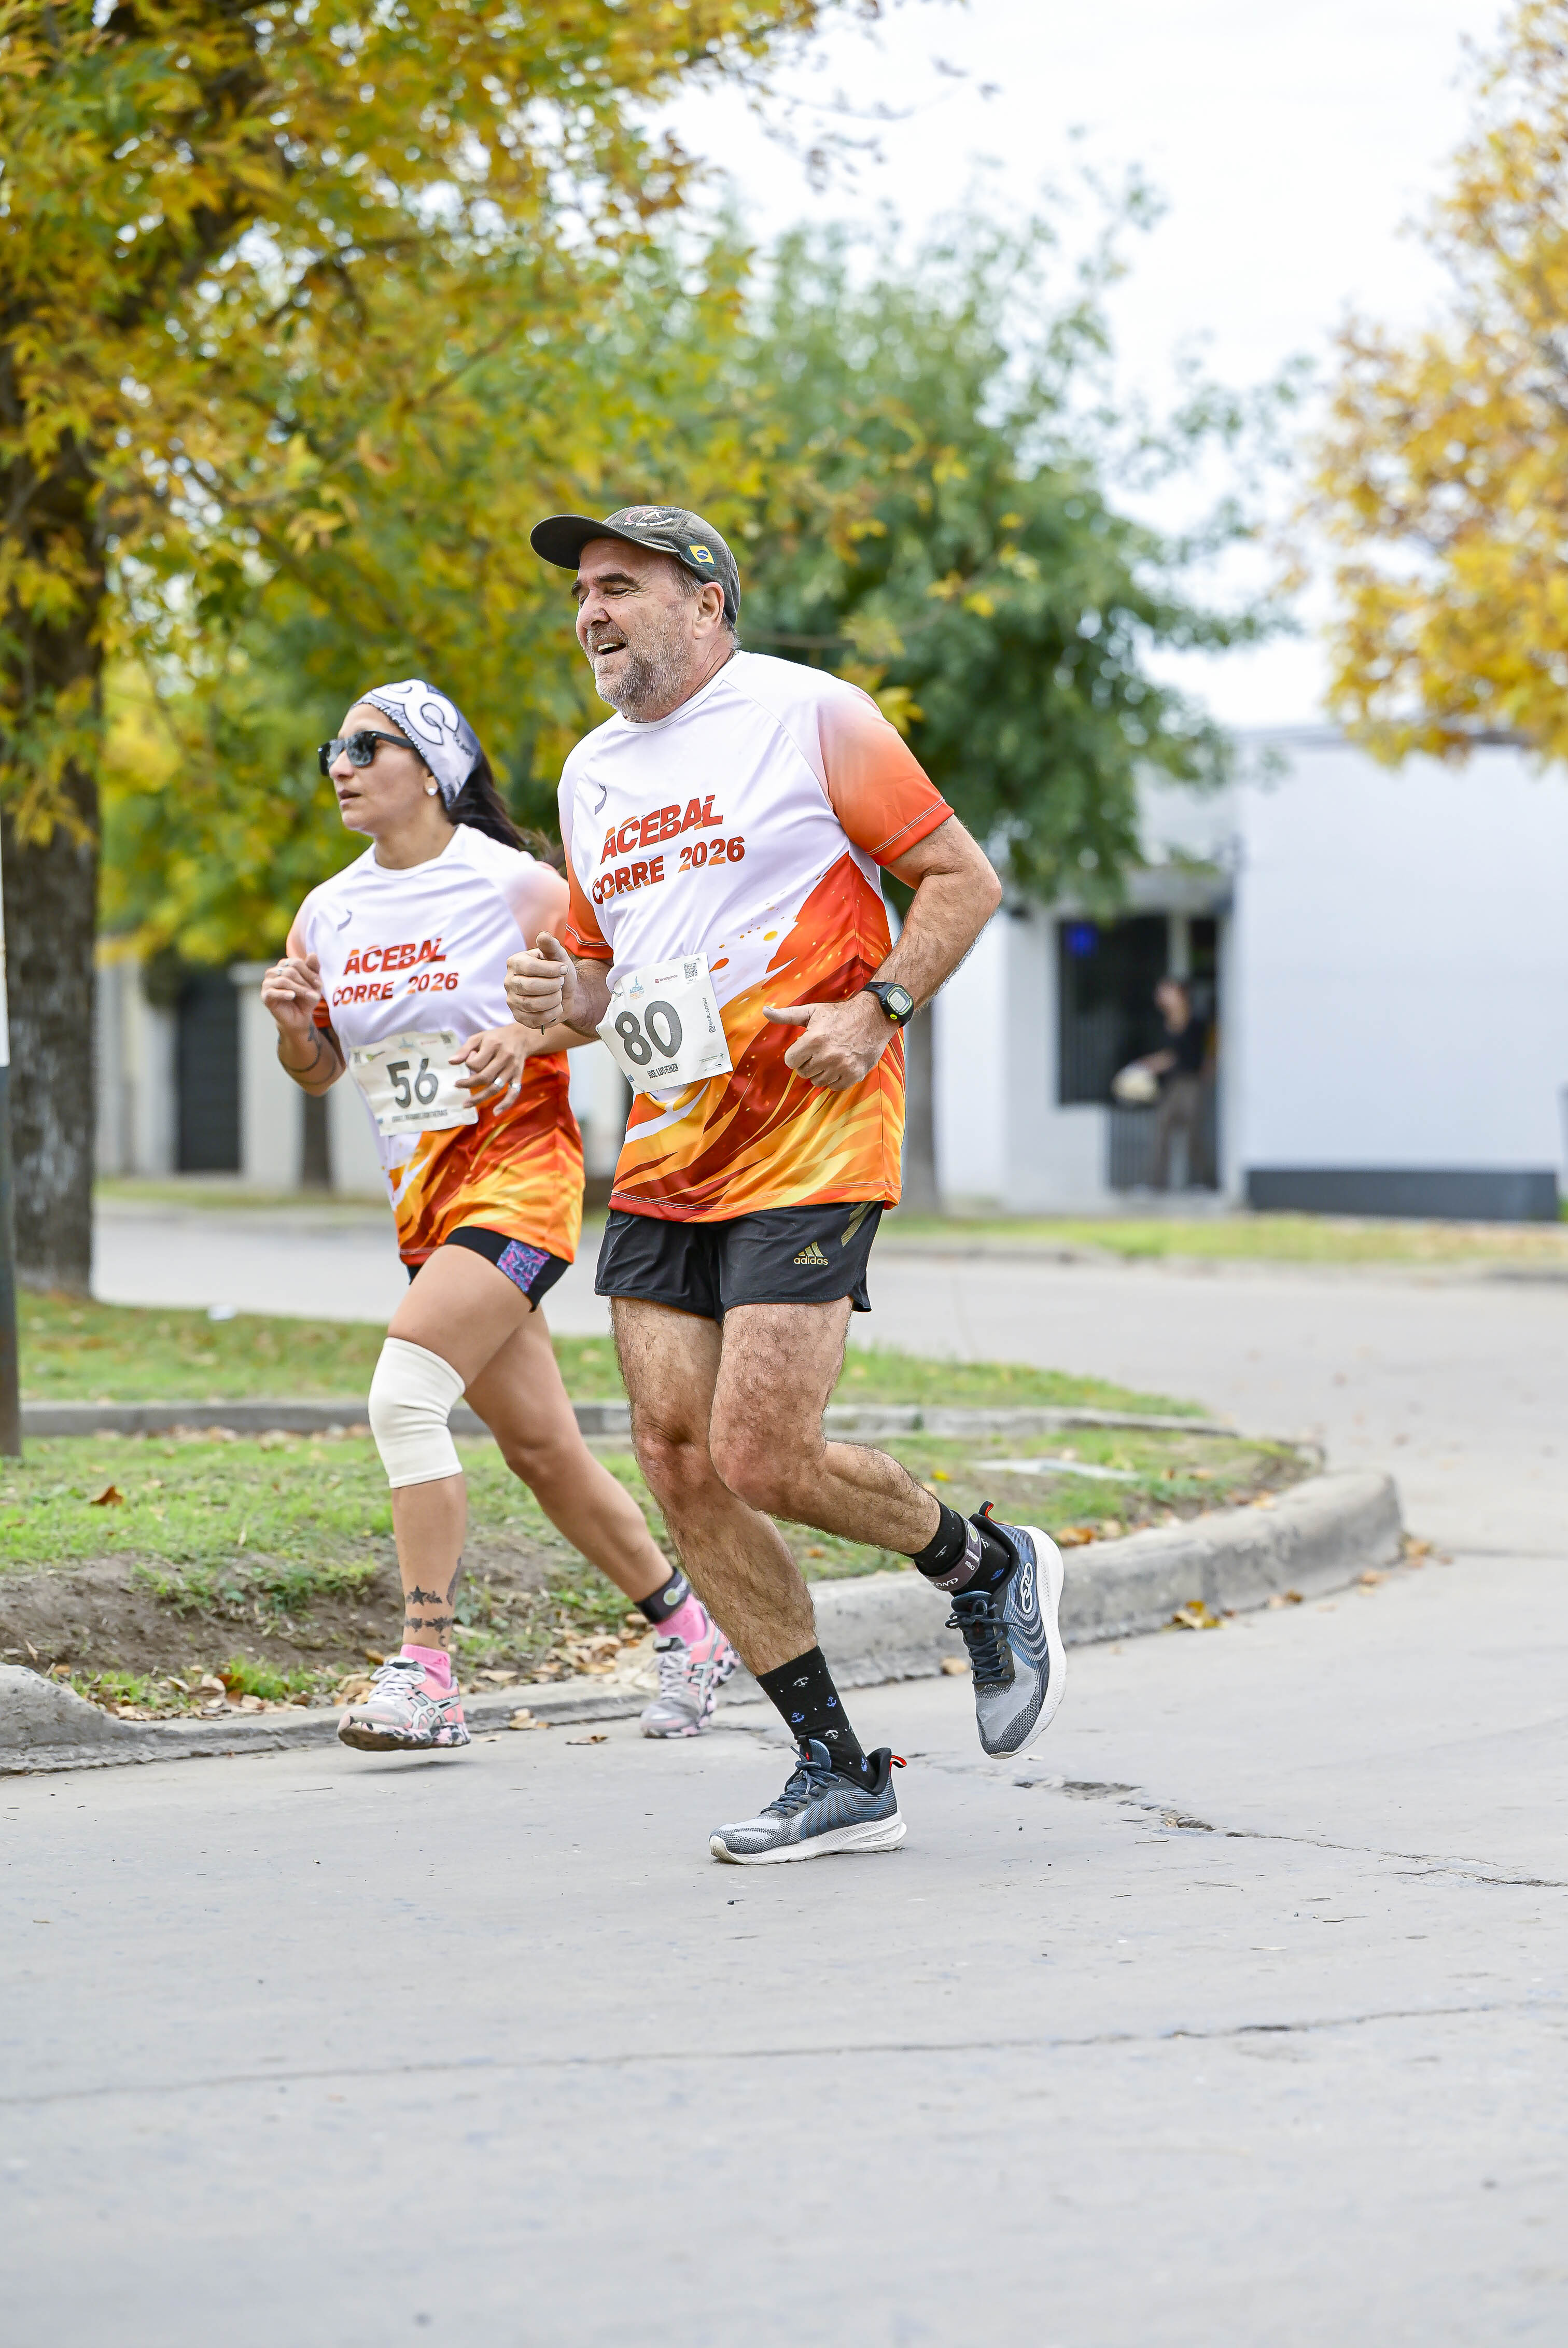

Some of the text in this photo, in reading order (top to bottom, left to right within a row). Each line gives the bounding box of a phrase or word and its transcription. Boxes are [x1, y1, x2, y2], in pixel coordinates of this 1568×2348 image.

[600, 794, 723, 864] ACEBAL
[592, 836, 745, 905] CORRE 2026
[343, 938, 446, 975] ACEBAL
[332, 972, 459, 1007] CORRE 2026
[614, 1000, 682, 1066] 80
[386, 1058, 439, 1108] 56
[793, 1255, 829, 1265] adidas
